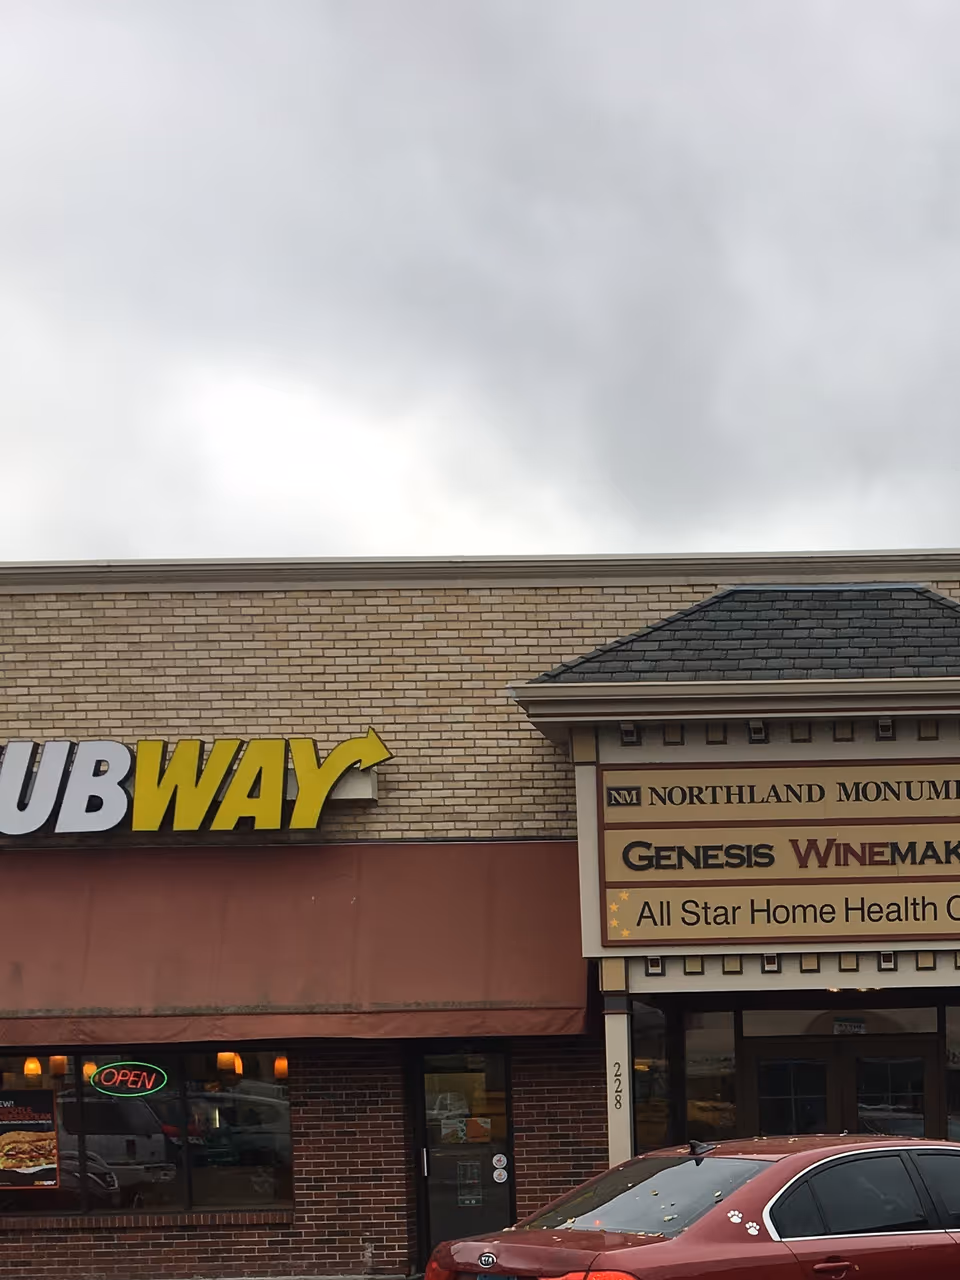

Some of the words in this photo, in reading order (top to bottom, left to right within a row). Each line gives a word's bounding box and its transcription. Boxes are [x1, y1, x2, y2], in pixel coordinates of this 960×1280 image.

[0, 726, 394, 835] UBWAY
[609, 789, 638, 805] NM
[647, 783, 826, 806] NORTHLAND
[622, 840, 775, 872] GENESIS
[636, 901, 671, 928] All
[680, 900, 741, 927] Star
[750, 898, 836, 925] Home
[844, 896, 938, 923] Health
[101, 1068, 156, 1090] OPEN
[613, 1061, 623, 1110] 228
